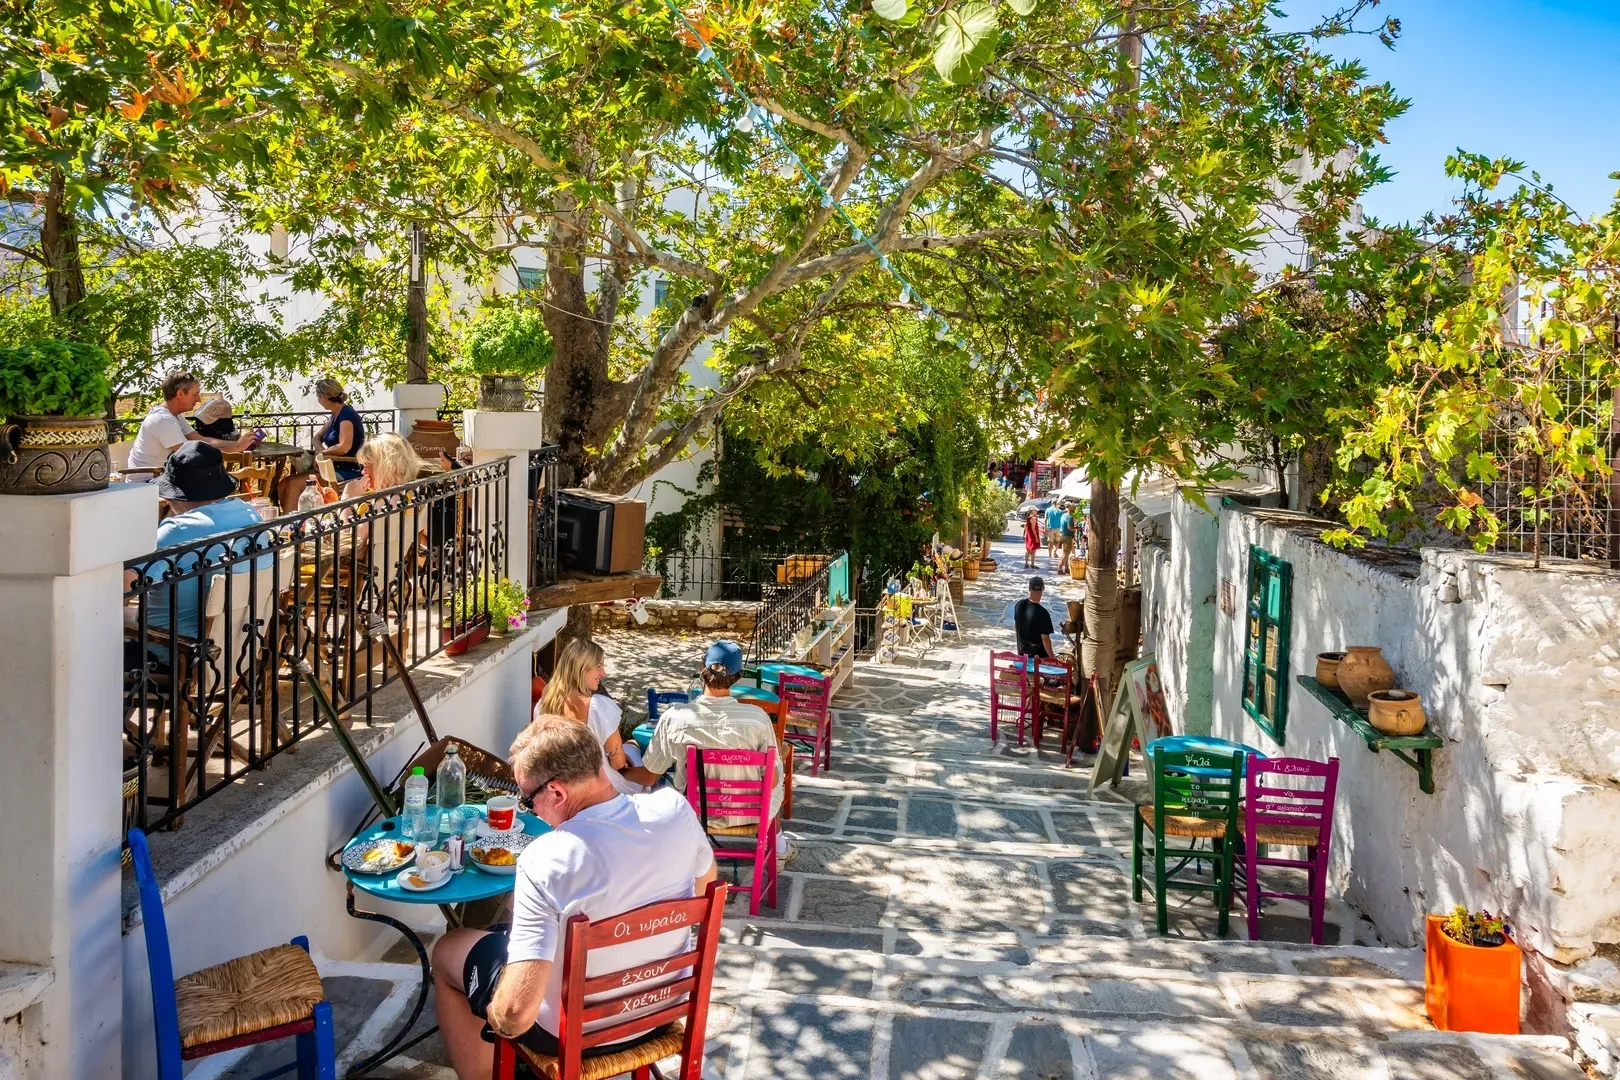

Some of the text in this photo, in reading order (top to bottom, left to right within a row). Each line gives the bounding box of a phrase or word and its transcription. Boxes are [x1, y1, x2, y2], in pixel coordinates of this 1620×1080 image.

[414, 443, 447, 452] Cinema
[1185, 754, 1211, 767] Ψηλά
[1270, 760, 1282, 771] Τι
[1283, 790, 1295, 798] να
[614, 910, 688, 938] Οι ωραίοι
[621, 961, 670, 986] έχουν
